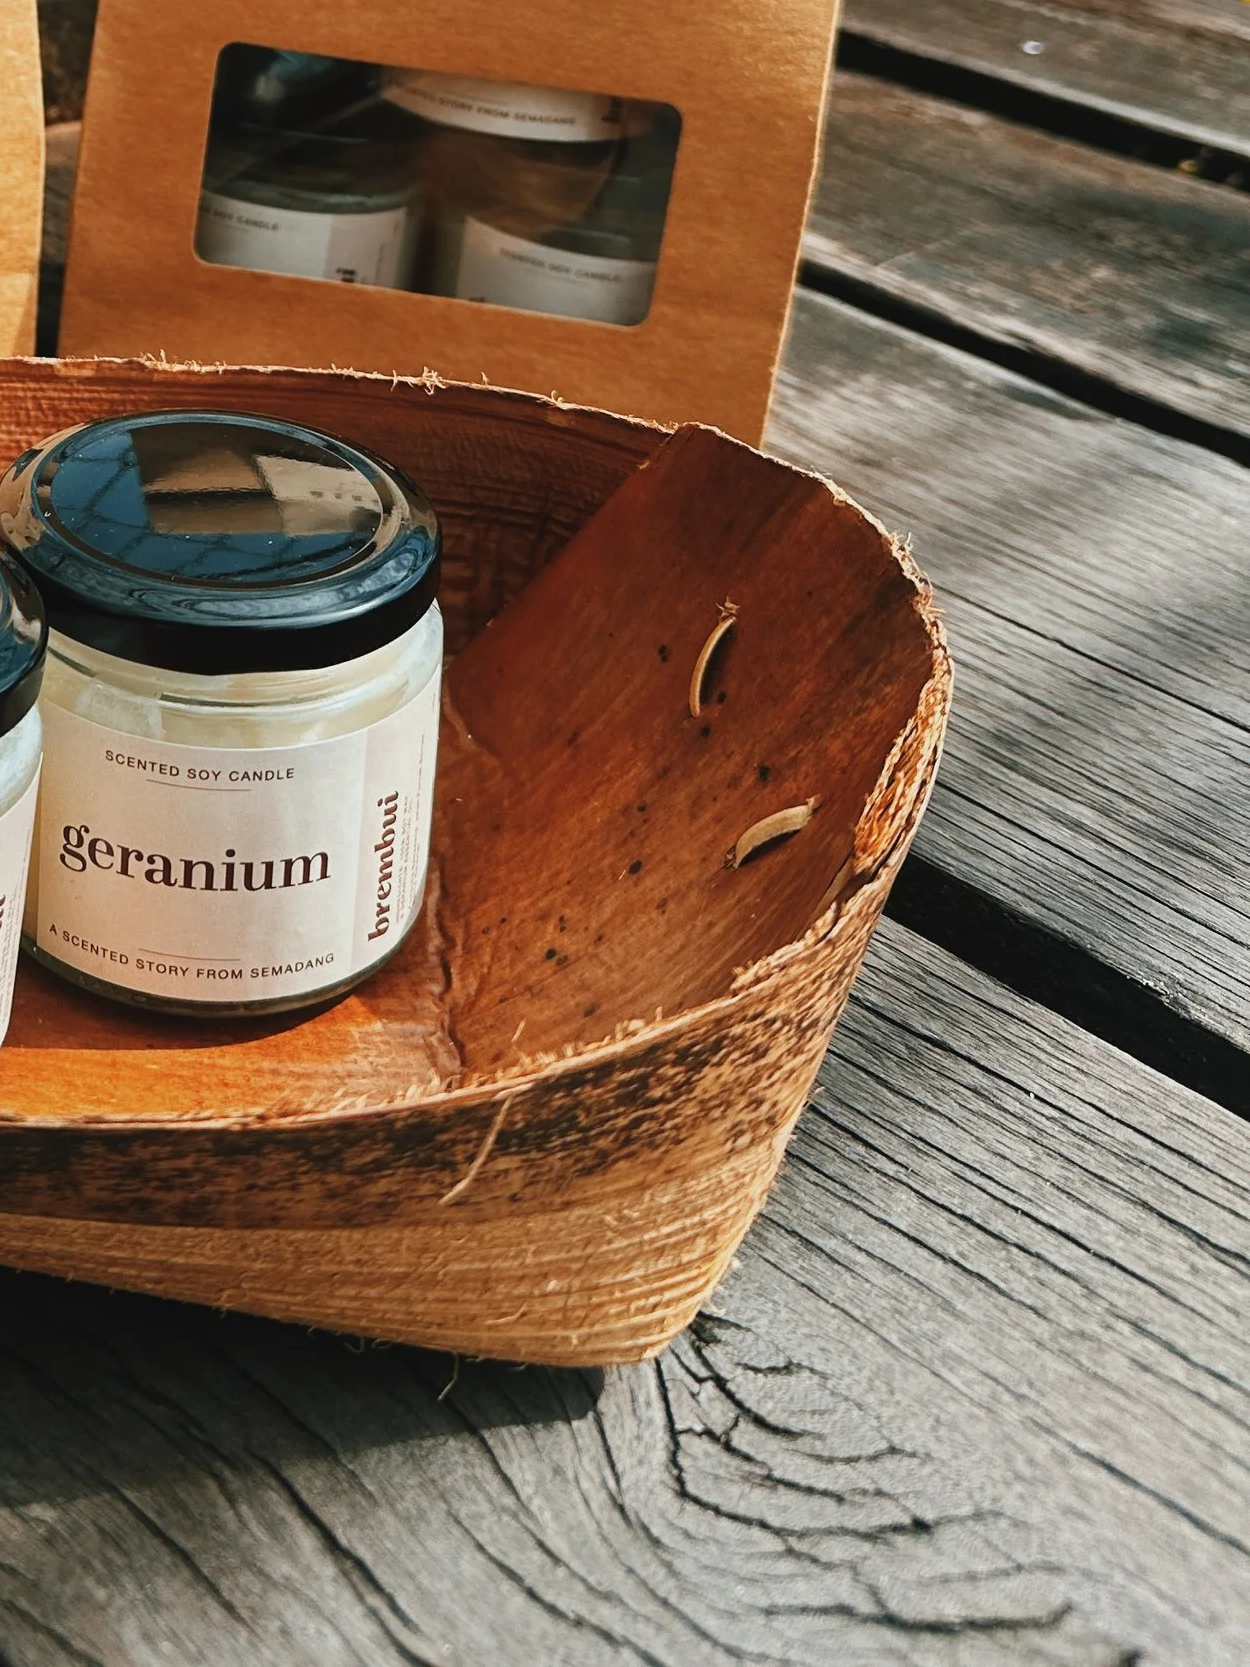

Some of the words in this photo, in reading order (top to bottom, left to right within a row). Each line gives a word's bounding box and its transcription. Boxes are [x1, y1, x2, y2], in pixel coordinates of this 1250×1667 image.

[104, 749, 180, 777] SCENTED
[187, 767, 222, 782] SOY
[228, 767, 296, 783] CANDLE
[59, 824, 331, 893] geranium
[368, 790, 400, 942] brembui
[49, 923, 58, 936] A
[62, 929, 130, 965] SCENTED
[135, 958, 190, 978] STORY
[196, 967, 244, 981] FROM
[250, 951, 335, 979] SEMADANG
